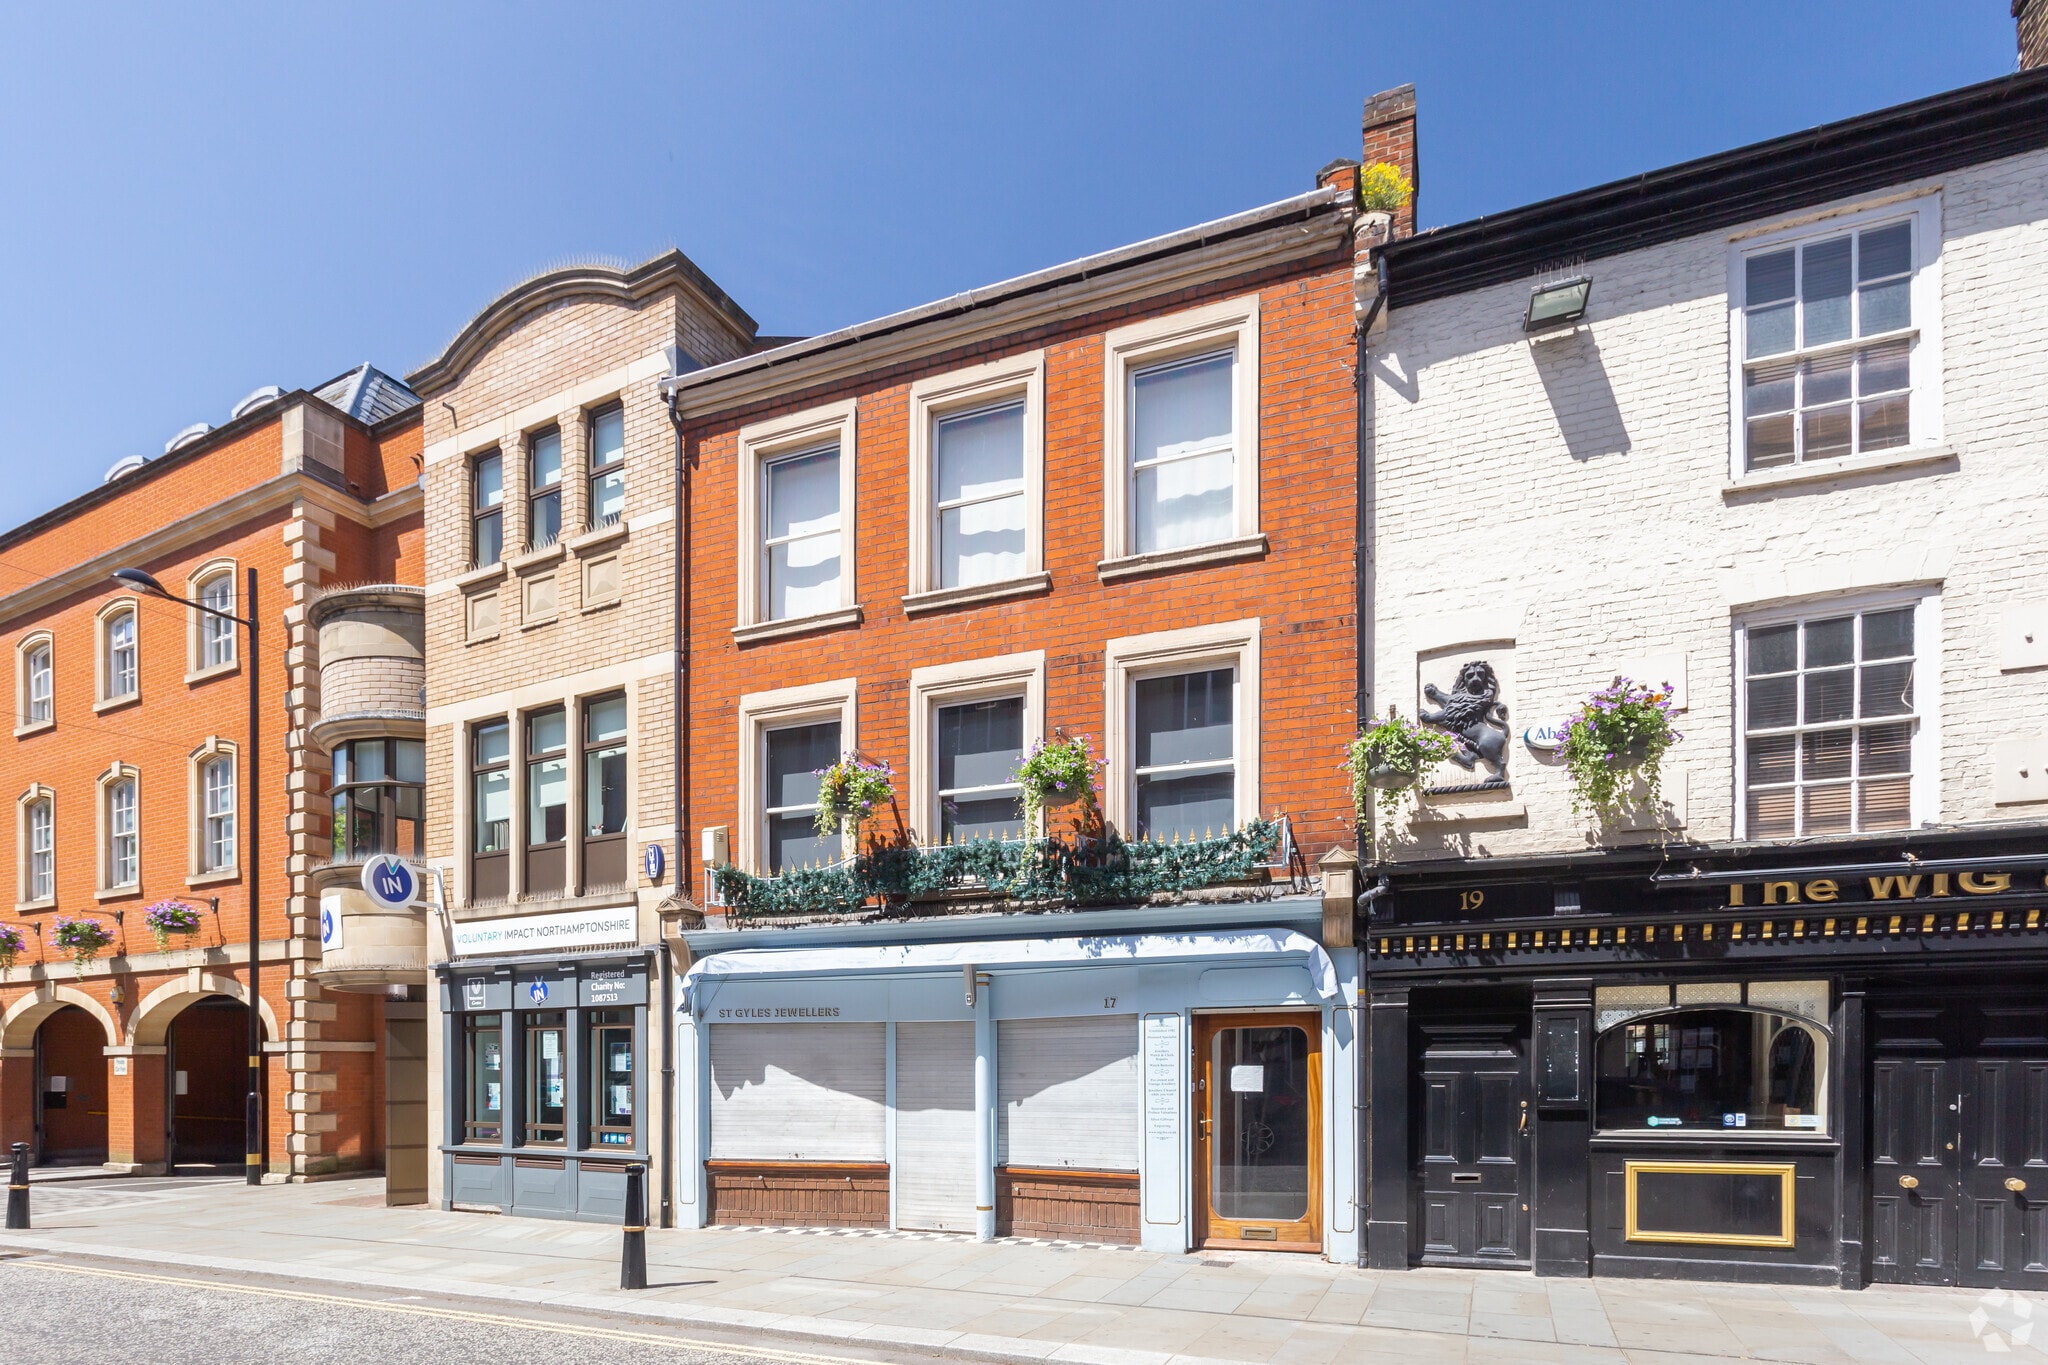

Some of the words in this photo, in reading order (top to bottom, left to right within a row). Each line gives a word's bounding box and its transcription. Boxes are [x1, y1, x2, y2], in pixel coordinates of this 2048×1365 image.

[1460, 890, 1484, 910] 19
[456, 931, 503, 944] VOLUNTARY
[504, 927, 535, 940] IMPACT
[536, 919, 631, 937] NORTHAMPTONSHIRE
[591, 970, 625, 981] Registered
[591, 983, 613, 992] Charity
[533, 988, 545, 1002] IN
[591, 993, 618, 1003] 1087513
[1104, 997, 1117, 1009] 17
[719, 1008, 732, 1018] ST
[735, 1008, 772, 1018] GYLES
[774, 1007, 840, 1017] JEWELLERS
